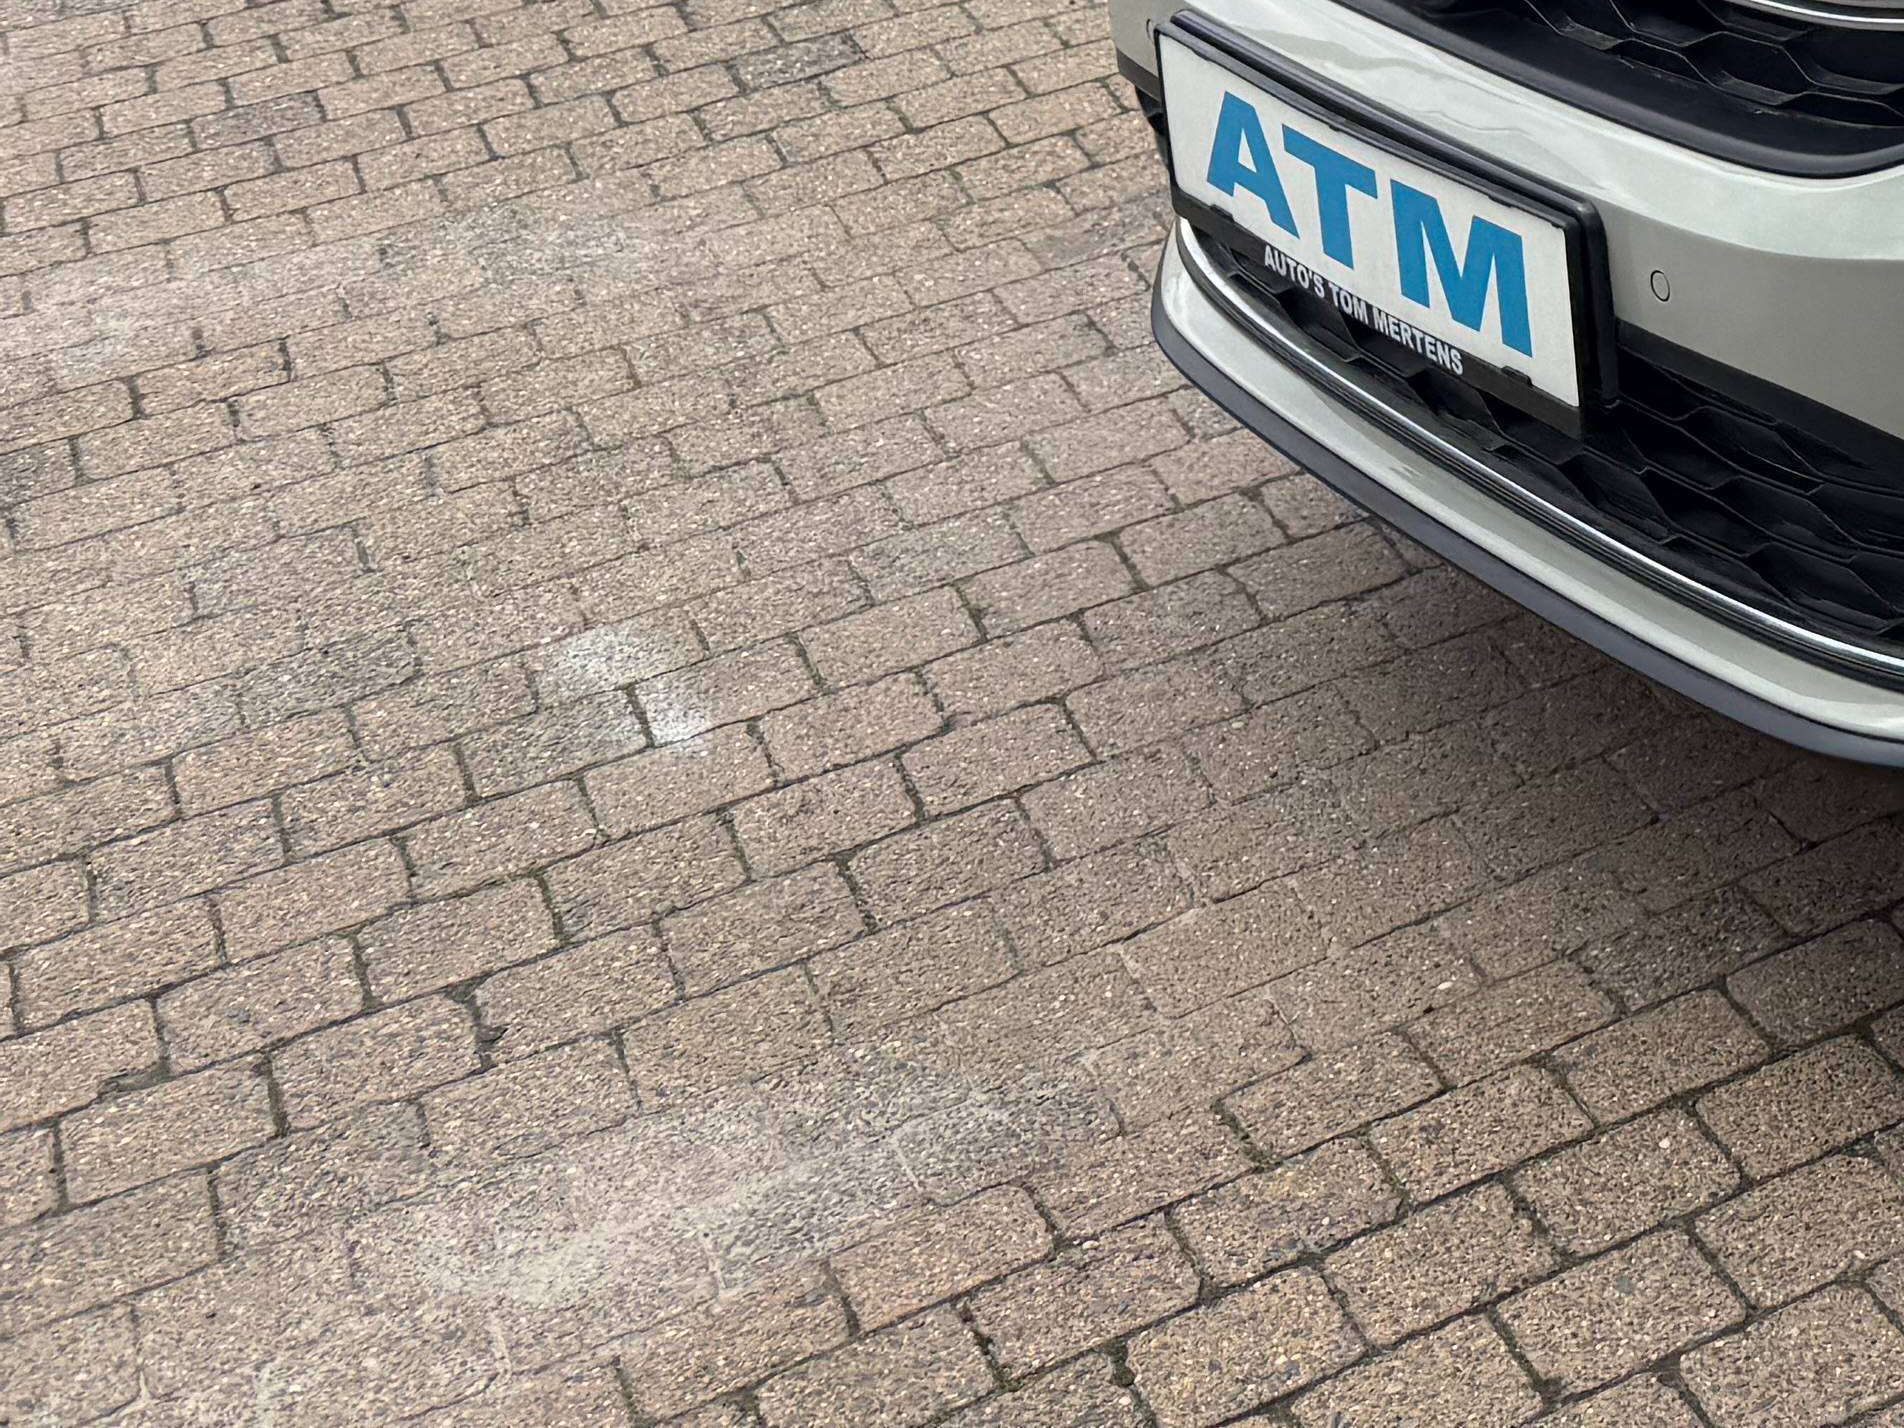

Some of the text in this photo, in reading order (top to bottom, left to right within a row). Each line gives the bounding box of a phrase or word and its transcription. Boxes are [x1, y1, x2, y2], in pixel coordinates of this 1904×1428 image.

[1206, 90, 1532, 358] ATM
[1263, 244, 1465, 377] AUTO'S TOM MERTENS
